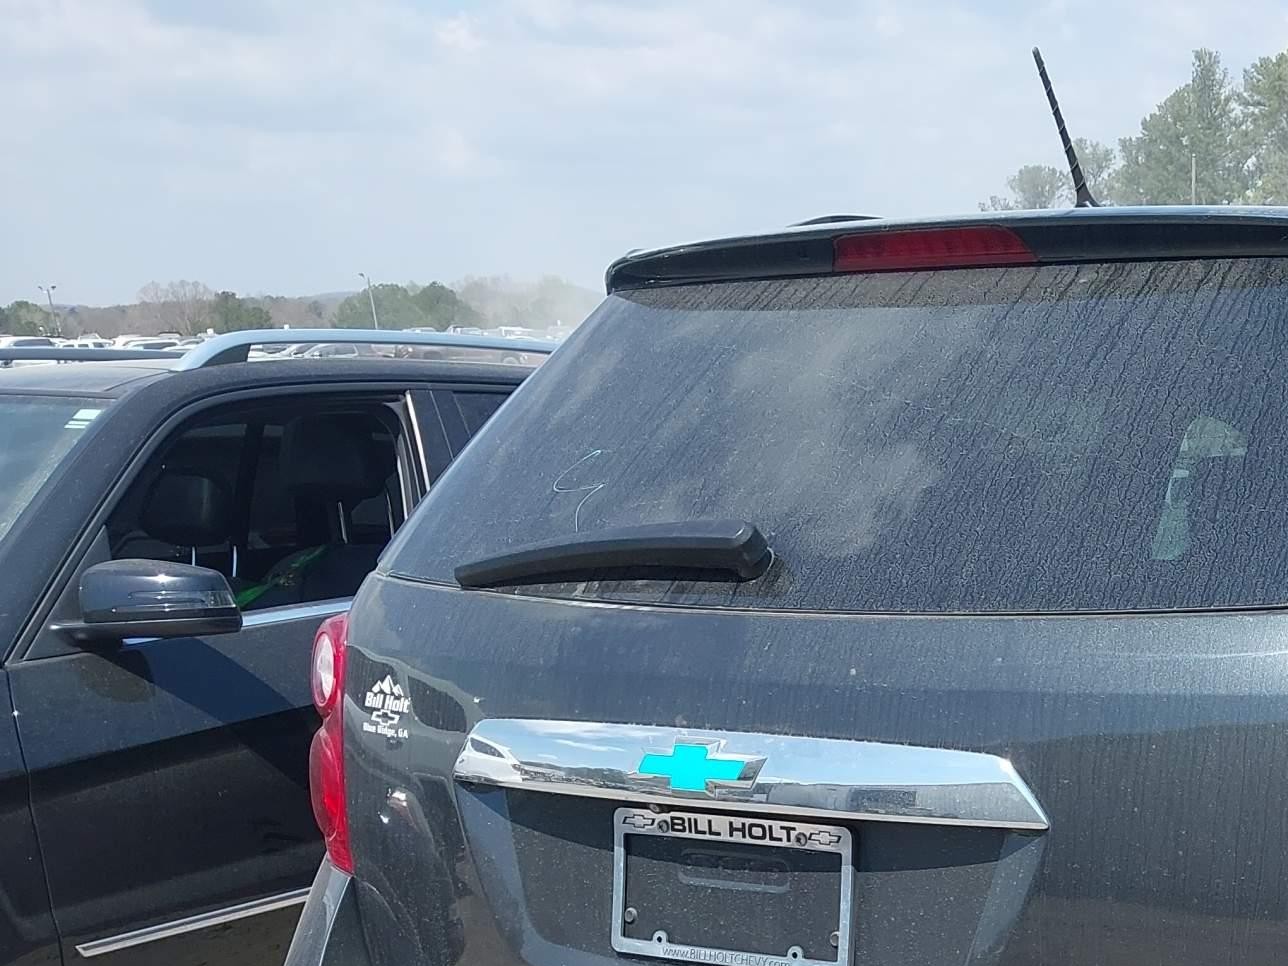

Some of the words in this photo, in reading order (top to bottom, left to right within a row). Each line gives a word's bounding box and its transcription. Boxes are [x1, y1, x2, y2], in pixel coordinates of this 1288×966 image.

[364, 691, 385, 709] Bill
[384, 694, 411, 714] Holt
[670, 816, 721, 837] BILL
[729, 822, 797, 843] HOLT
